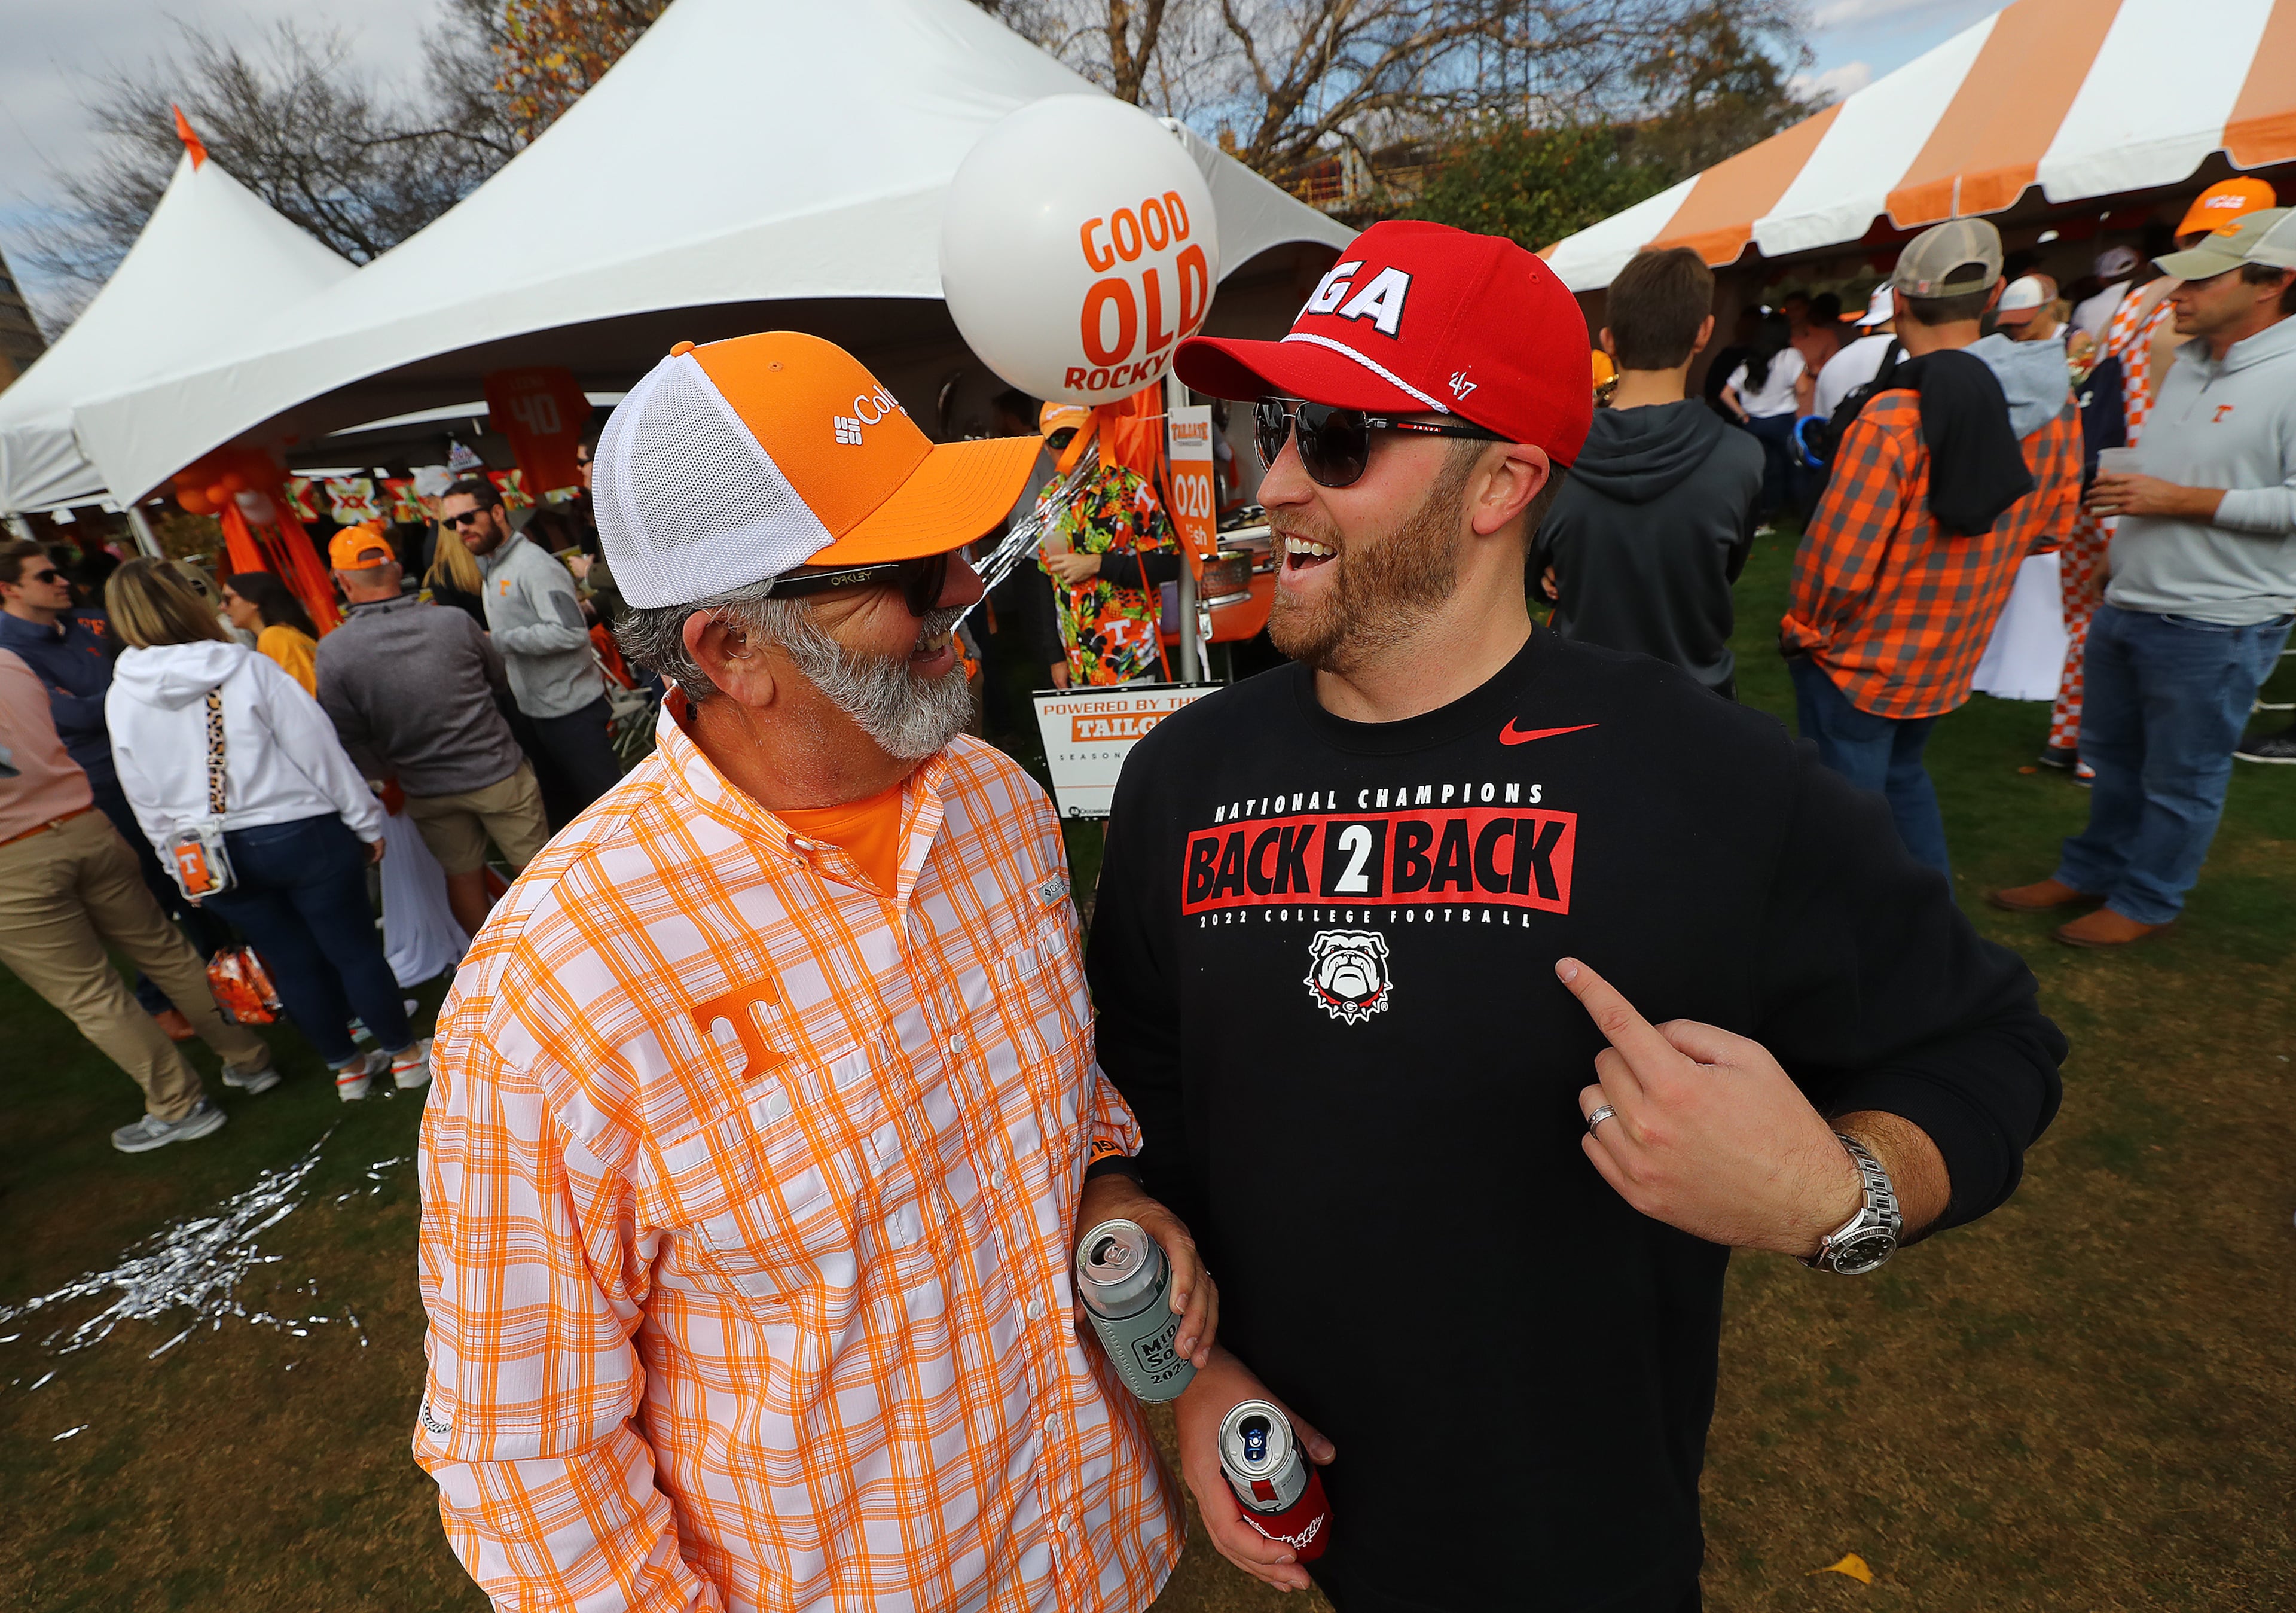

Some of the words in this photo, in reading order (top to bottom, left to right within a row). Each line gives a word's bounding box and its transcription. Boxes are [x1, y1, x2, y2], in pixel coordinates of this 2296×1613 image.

[1080, 190, 1190, 272] GOOD
[1080, 243, 1208, 367] OLD
[1293, 262, 1413, 339] GA
[1064, 350, 1170, 391] ROCKY
[509, 393, 562, 435] 40
[2211, 404, 2234, 423] T
[1175, 474, 1211, 519] 020
[831, 570, 872, 586] OAKLEY
[1104, 618, 1131, 646] T
[1044, 700, 1128, 715] POWERED
[1136, 698, 1161, 711] BY
[1077, 716, 1165, 738] TAILG
[1059, 752, 1120, 761] SEASON
[1214, 790, 1336, 822] NATIONAL
[1358, 783, 1543, 809] CHAMPIONS
[179, 853, 198, 875] T
[1187, 824, 1317, 905] BACK
[1334, 824, 1372, 893] 2
[1391, 817, 1567, 902] BACK
[1200, 911, 1247, 928] 2022
[1265, 910, 1371, 923] COLLEGE
[1390, 910, 1530, 928] FOOTBALL
[690, 975, 788, 1083] T
